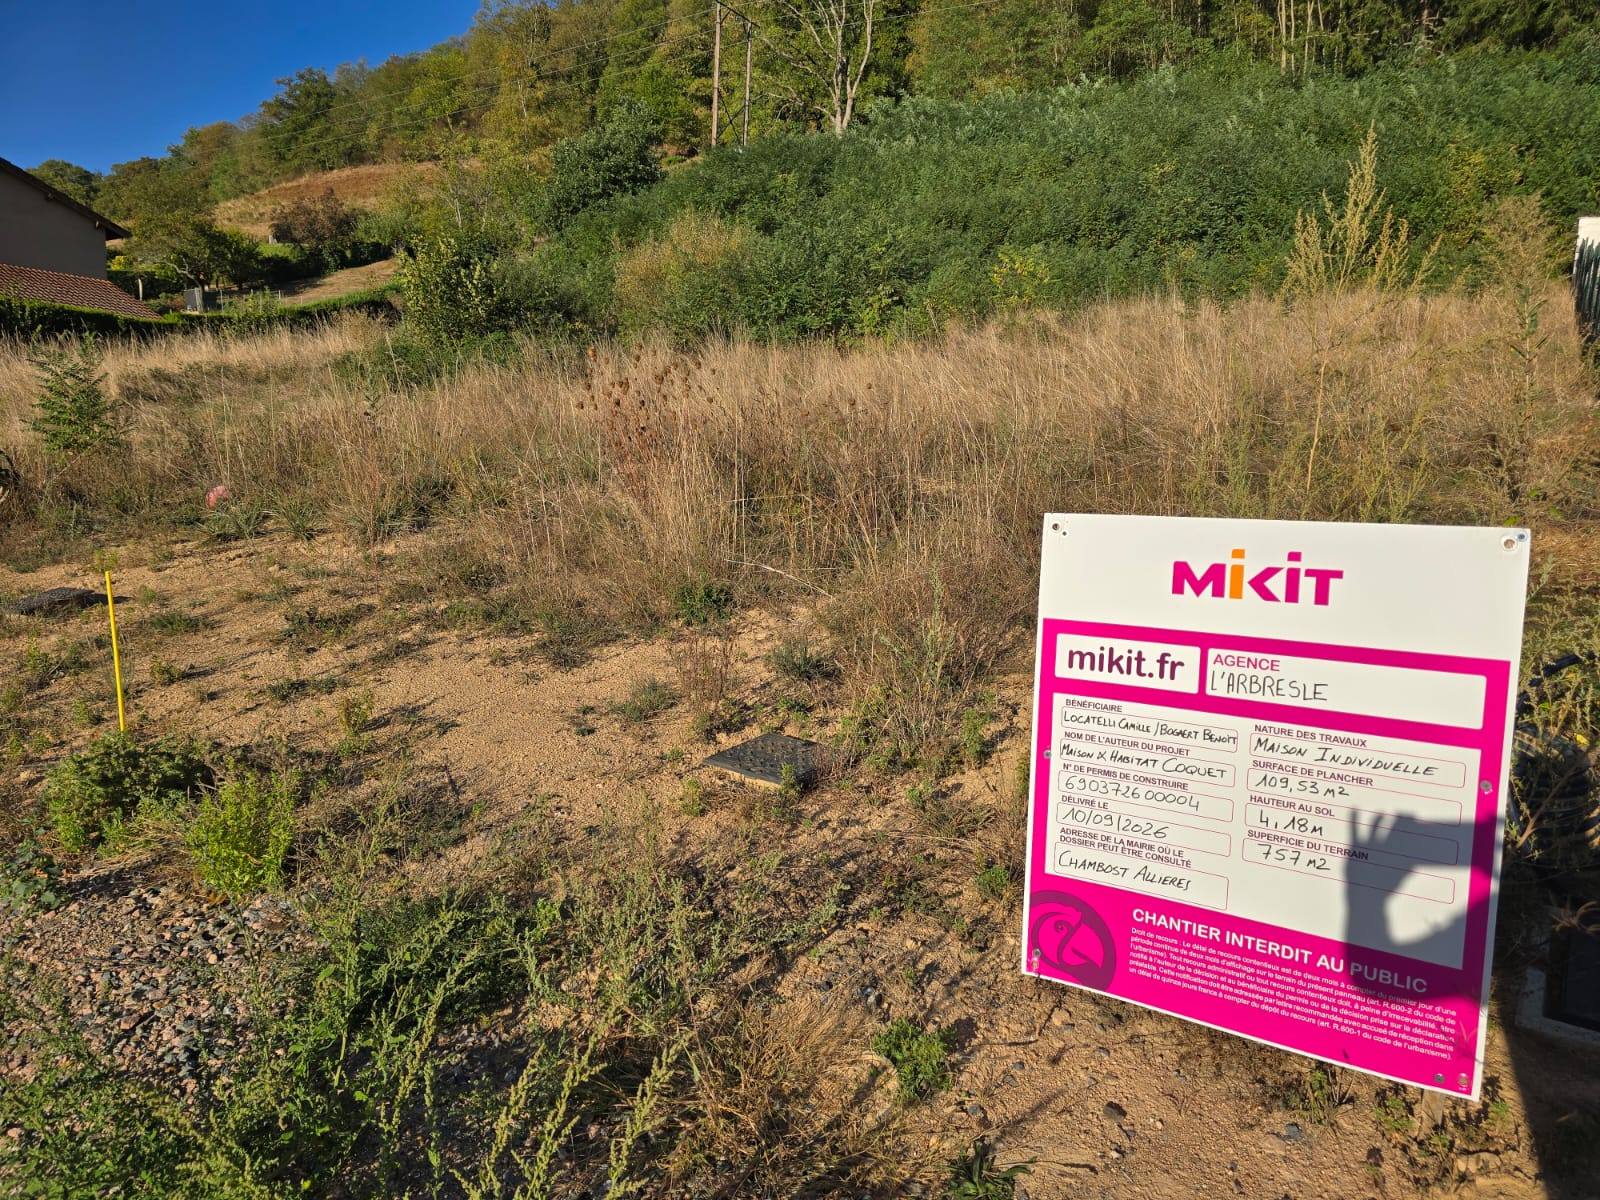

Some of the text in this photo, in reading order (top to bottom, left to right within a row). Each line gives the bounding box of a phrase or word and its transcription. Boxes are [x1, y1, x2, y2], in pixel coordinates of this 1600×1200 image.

[1068, 646, 1185, 681] mikit.fr
[1213, 654, 1280, 671] AGENCE
[1210, 669, 1328, 702] L'ARBRESLE
[1066, 699, 1122, 712] BÉNÉFICIAIRE
[1064, 731, 1190, 757] NOM DE L'AUTEUR DU PROJET
[1254, 725, 1367, 747] NATURE DES TRAVAUX
[1063, 763, 1188, 790] N° DE PERMIS DE CONSTRUIRE
[1162, 758, 1227, 778] COQUET
[1252, 760, 1373, 786] SURFACE DE PLANCHER
[1061, 795, 1096, 808] DÉLIVRÉ
[1250, 795, 1335, 817] HAUTEUR AU SOL
[1062, 807, 1169, 839] 10/09/2026
[1060, 827, 1184, 858] ADRESSE DE LA MAIRIE OÙ LE
[1060, 835, 1191, 868] DOSSIER PEUT ÊTRE CONSULTÉ
[1248, 830, 1369, 861] SUPERFICIE DU TERRAIN
[1258, 843, 1302, 865] 757
[1059, 850, 1129, 878] CHAMBOST
[1133, 909, 1428, 993] CHANTIER INTERDIT AU PUBLIC
